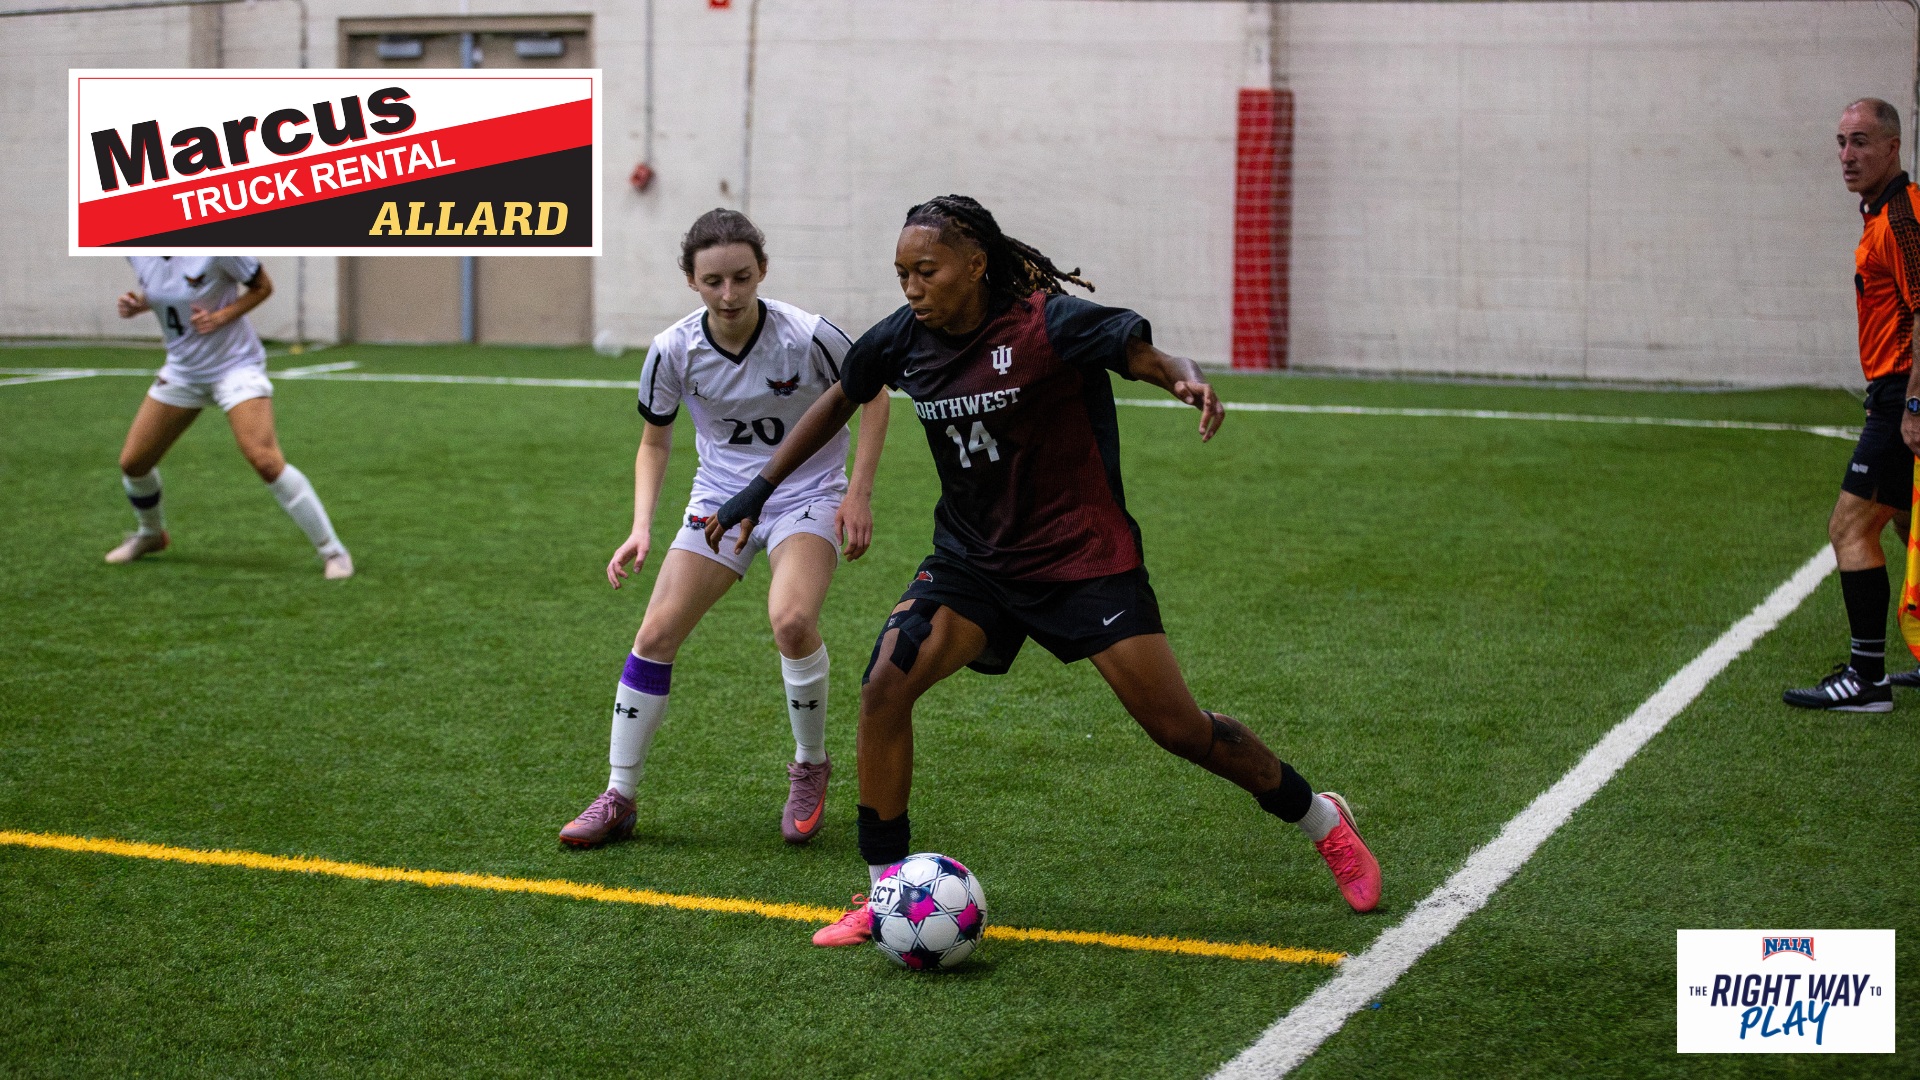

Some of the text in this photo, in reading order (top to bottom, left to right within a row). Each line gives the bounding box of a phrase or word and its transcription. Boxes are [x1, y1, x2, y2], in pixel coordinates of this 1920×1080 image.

[722, 417, 784, 445] 20
[945, 420, 1000, 468] 14
[870, 885, 896, 905] ECT
